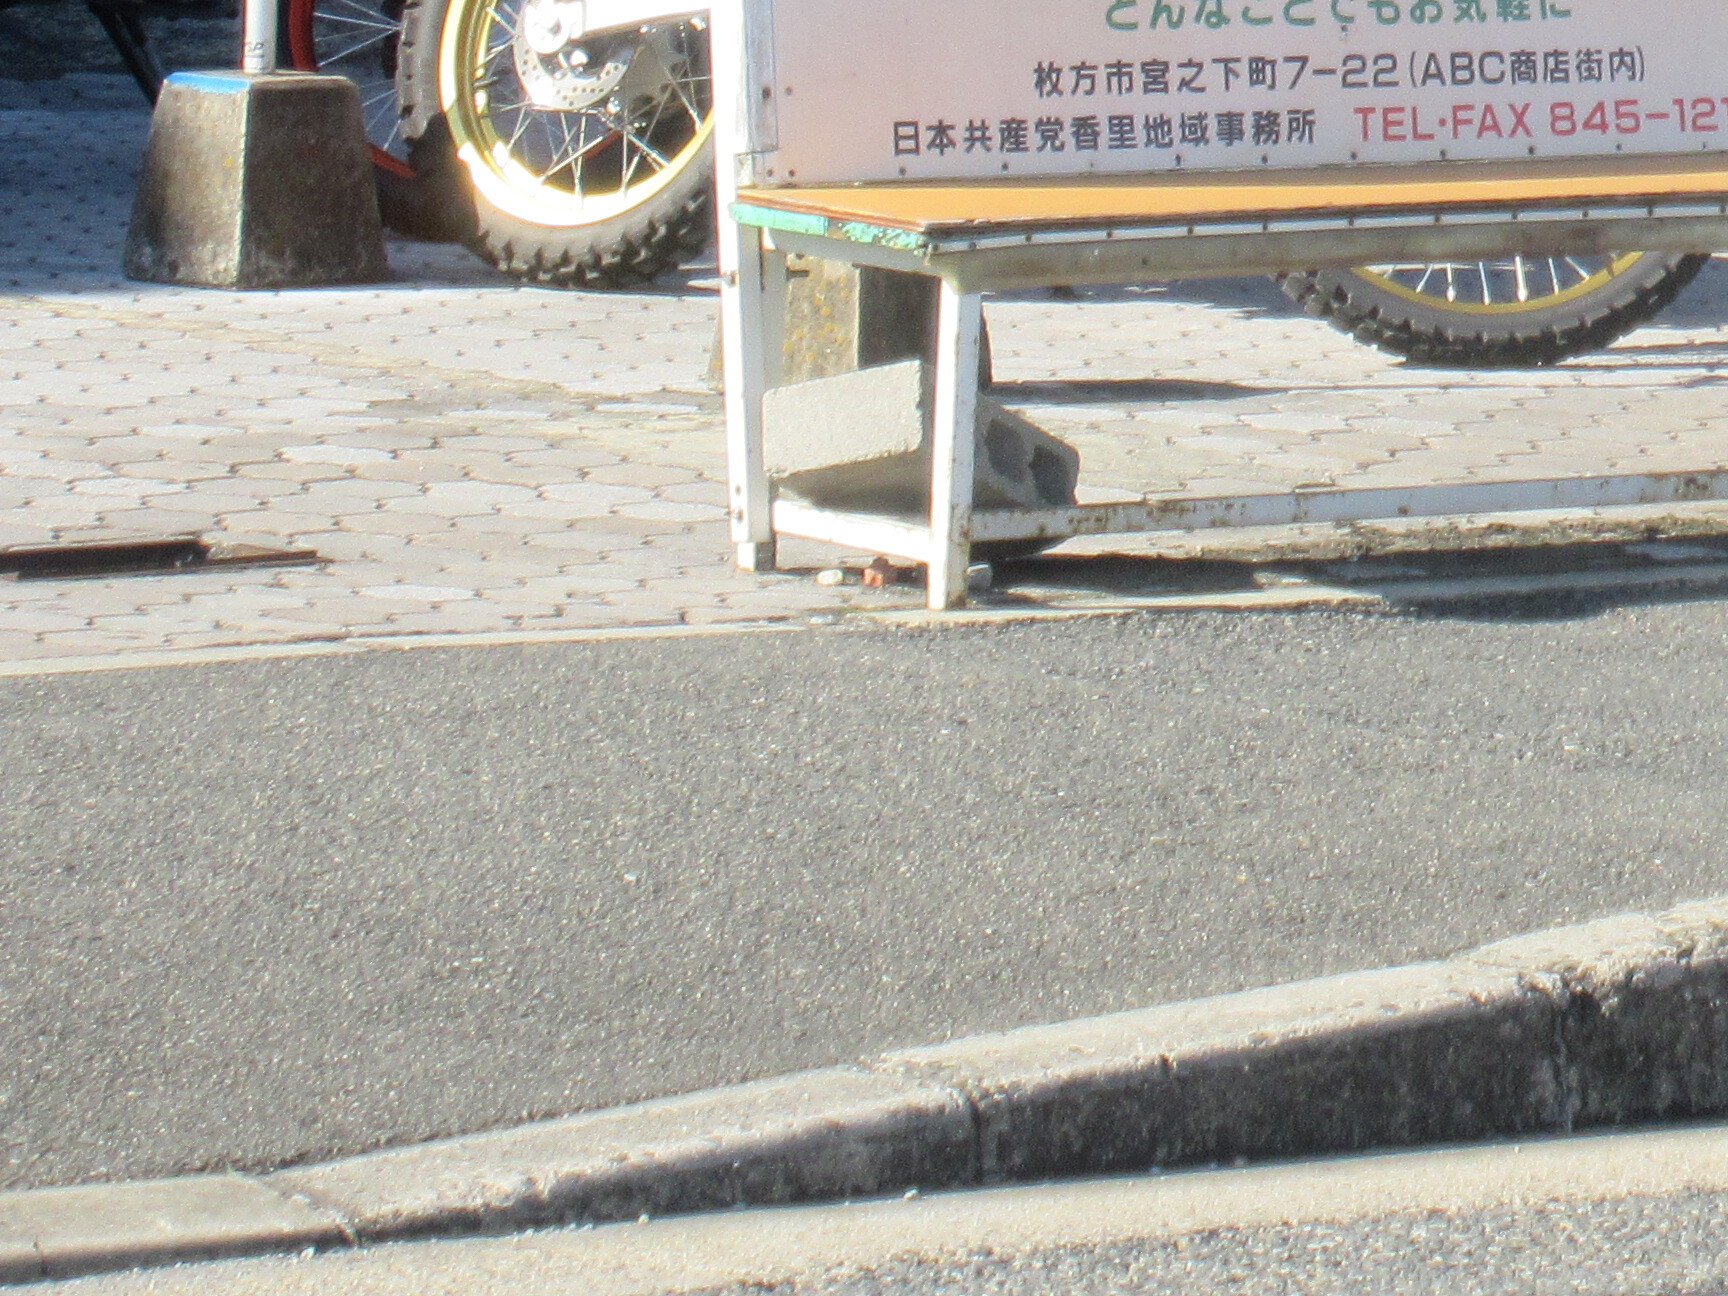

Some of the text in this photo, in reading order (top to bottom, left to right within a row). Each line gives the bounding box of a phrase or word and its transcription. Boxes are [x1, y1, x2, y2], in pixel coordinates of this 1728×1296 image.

[893, 107, 1316, 157] 日本共産党香里地域事務所
